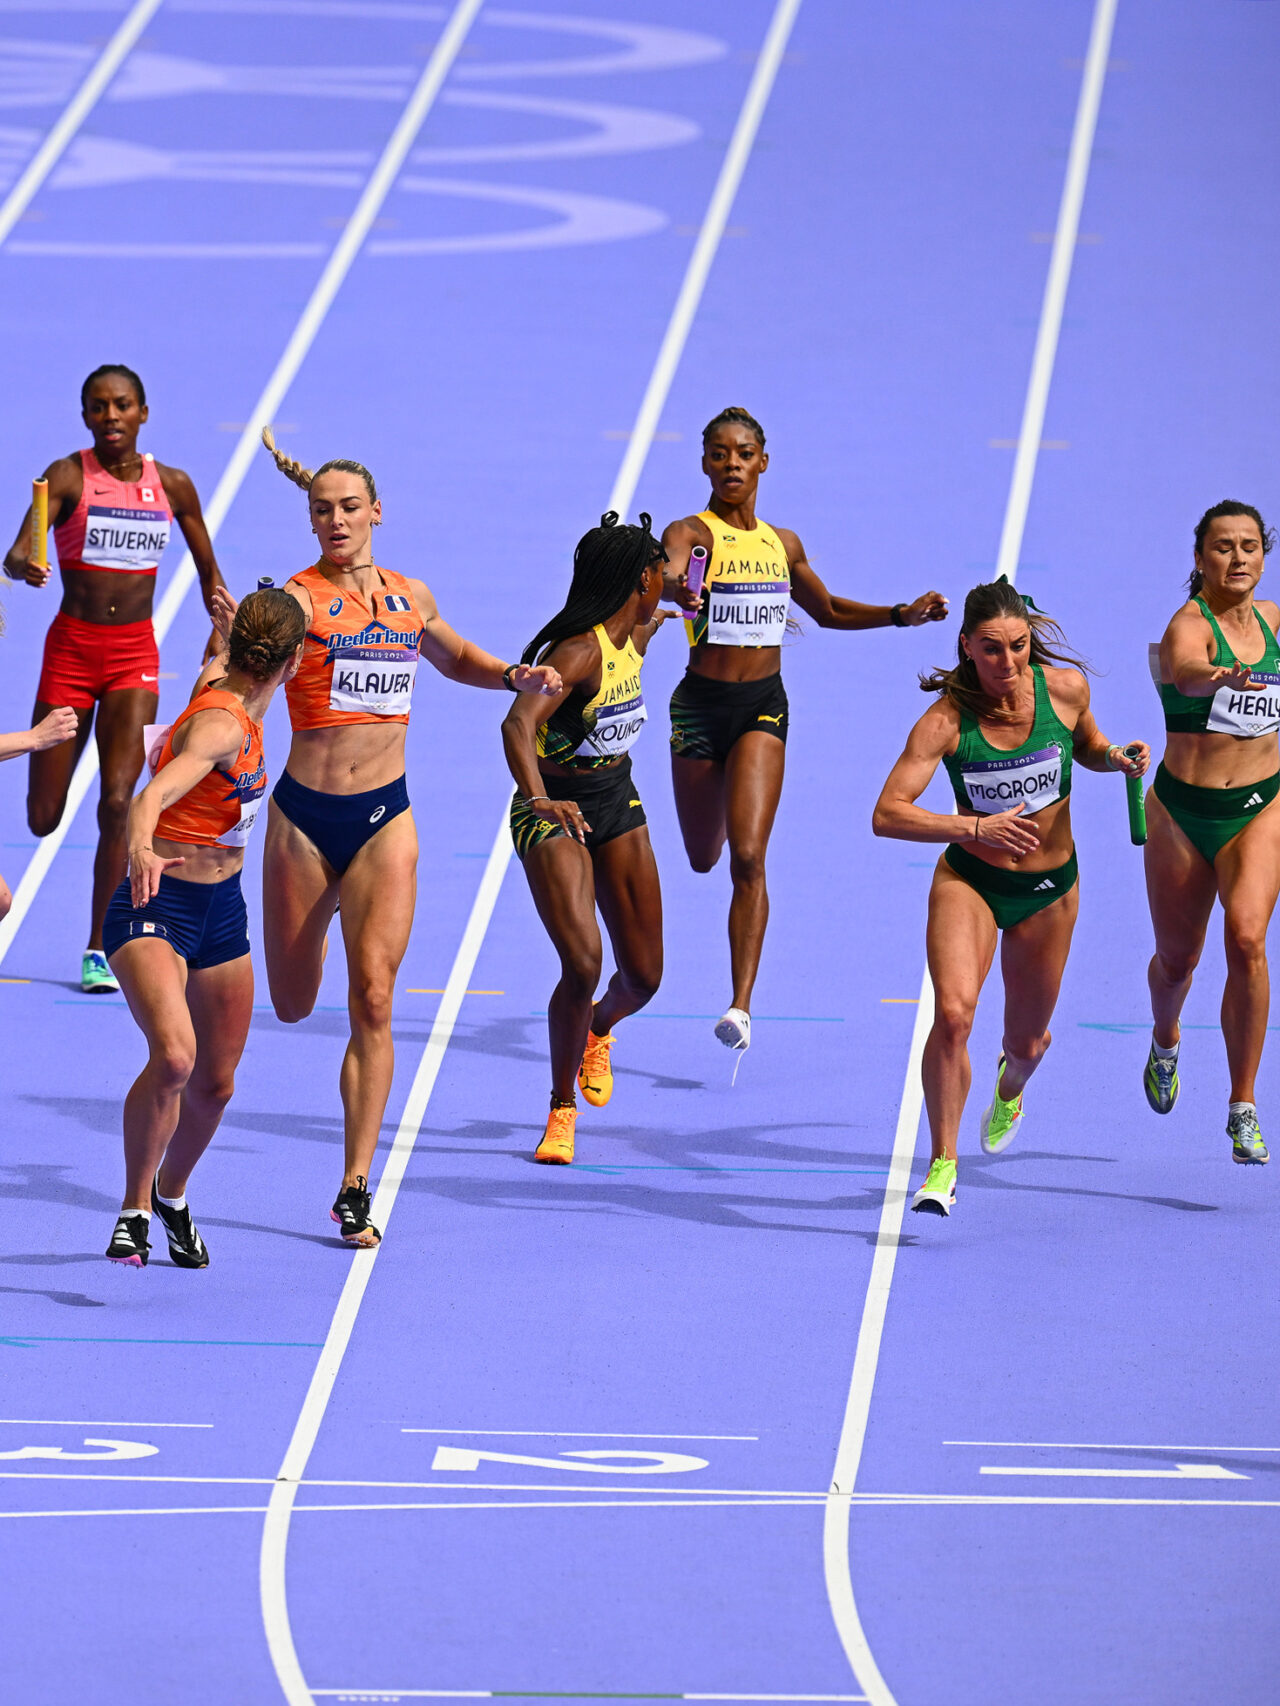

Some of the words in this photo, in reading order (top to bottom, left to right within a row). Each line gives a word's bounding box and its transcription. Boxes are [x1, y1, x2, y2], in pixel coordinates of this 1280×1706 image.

[111, 509, 135, 517] PARIS
[88, 528, 166, 550] STIVERNE
[714, 560, 788, 578] JAMAICA
[734, 584, 756, 592] PARIS
[757, 584, 776, 592] 2024
[712, 604, 786, 625] WILLIAMS
[359, 651, 382, 659] PARIS
[338, 670, 411, 694] KLAVER
[599, 674, 641, 706] JAMAIC
[1014, 756, 1036, 766] 2024
[431, 1446, 710, 1474] 2
